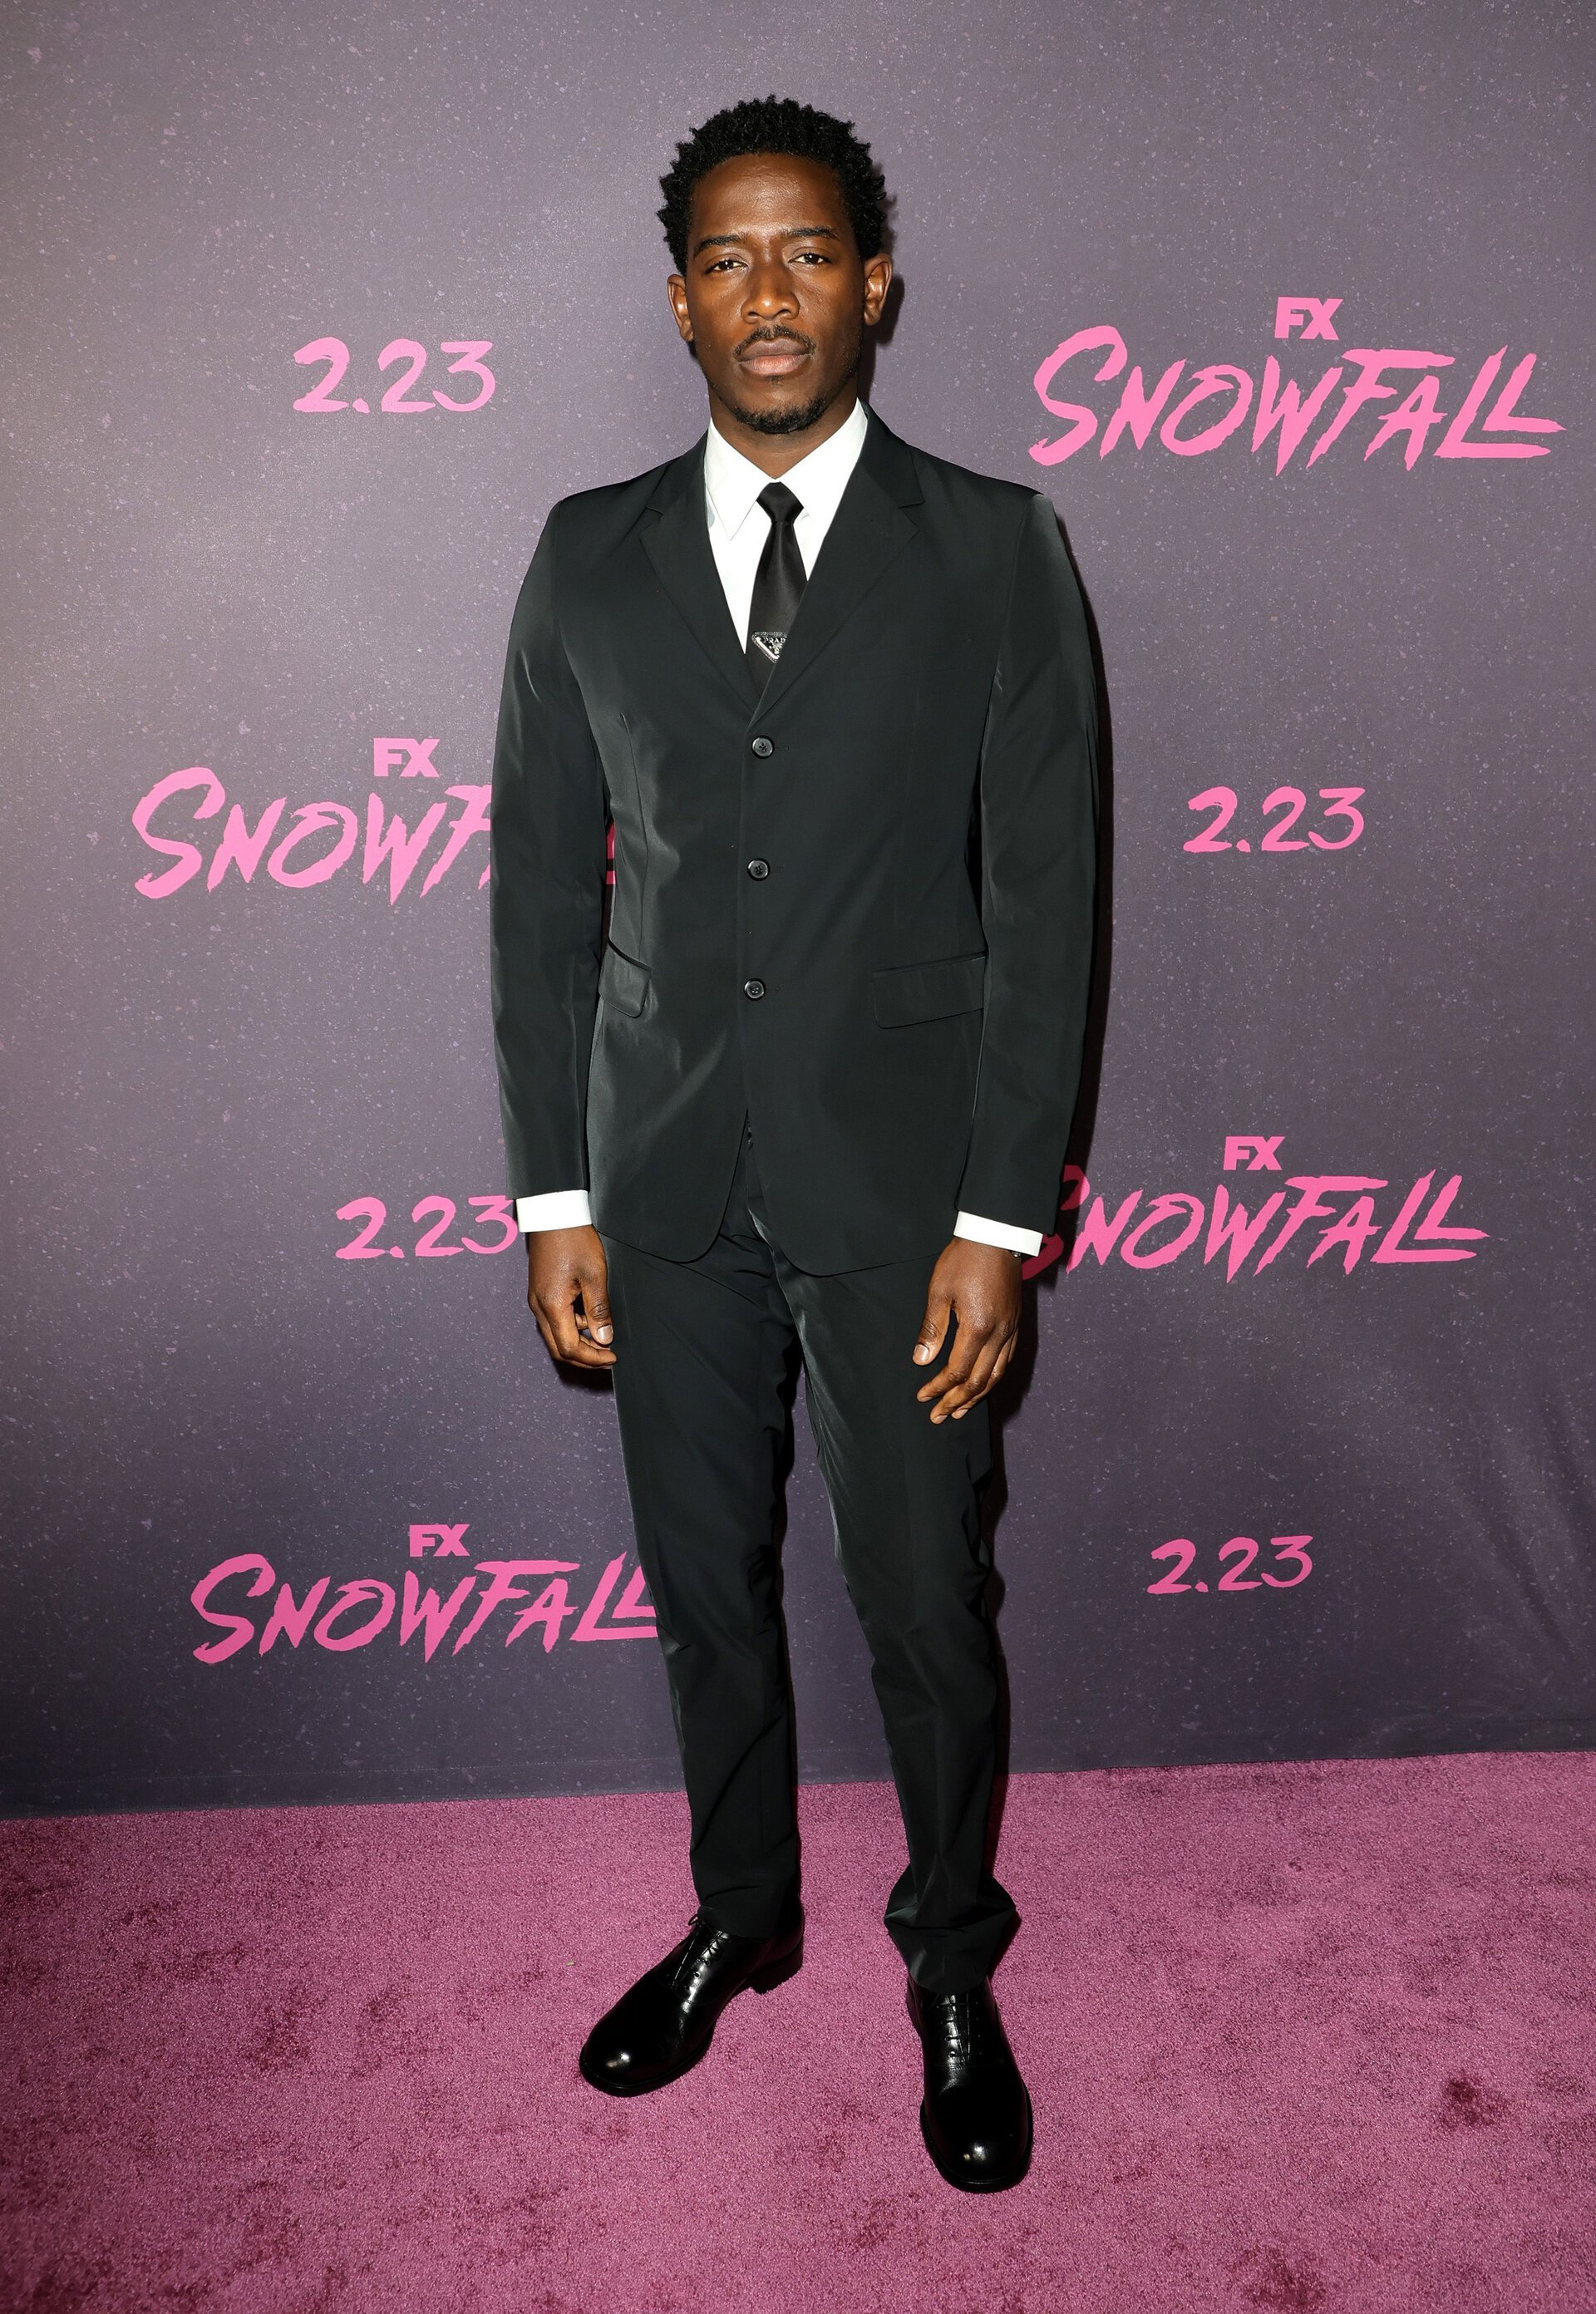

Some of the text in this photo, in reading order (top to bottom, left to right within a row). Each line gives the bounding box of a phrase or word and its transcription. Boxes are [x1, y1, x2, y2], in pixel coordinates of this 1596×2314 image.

[1273, 296, 1342, 341] FX
[293, 338, 495, 414] 2.23
[1030, 326, 1564, 475] SNOWFALL
[374, 738, 440, 777] FX
[1184, 785, 1365, 854] 2.23
[1223, 1135, 1285, 1171] FX
[335, 1195, 518, 1259] 2.23
[408, 1524, 470, 1558] FX
[1147, 1536, 1313, 1594] 2.23
[190, 1552, 658, 1663] SNOWFALL
